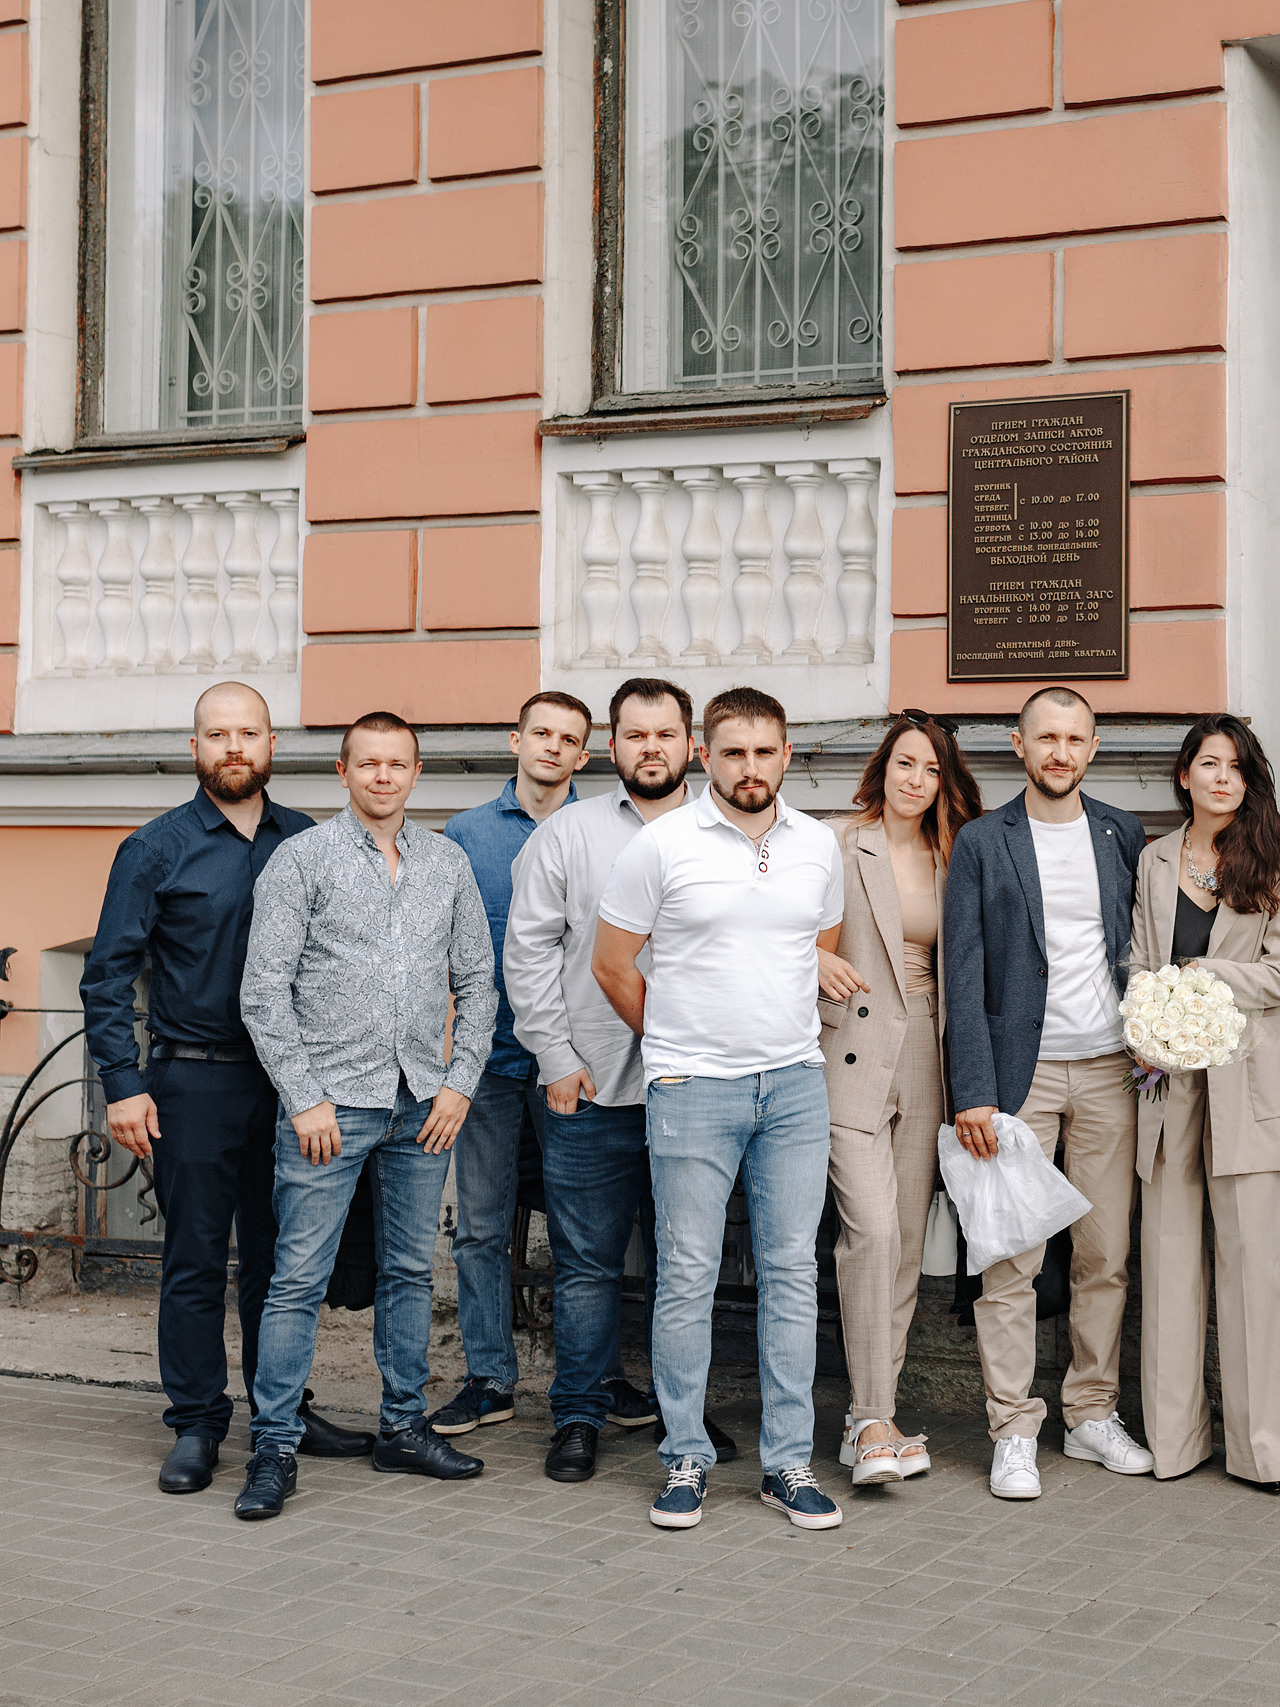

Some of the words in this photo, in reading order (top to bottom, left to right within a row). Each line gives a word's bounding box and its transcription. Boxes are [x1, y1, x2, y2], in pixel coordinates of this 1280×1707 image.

[991, 420, 1027, 430] ПРИЕМ
[1031, 416, 1083, 427] ГРАЖДАН
[971, 433, 1019, 444] ОТДЕЛОМ
[1024, 431, 1065, 441] ЗАПИСИ
[1070, 428, 1103, 437] АКТОВ
[962, 444, 1046, 458] ГРАЖДАНСКОГО
[1050, 440, 1113, 452] СОСТОЯНИЯ
[974, 457, 1053, 470] ЦЕНТРАЛЬНОГО
[1058, 453, 1099, 464] РАЙОНА
[974, 483, 1011, 492] ВТОРНИК
[974, 494, 1001, 502] СРЕДА
[1031, 495, 1054, 504] 10.00
[1076, 493, 1100, 502] 17.00
[974, 504, 1009, 512] ЧЕТВЕРГ
[974, 514, 1012, 522] ПЯТНИЦА
[974, 525, 1011, 533] СУББОТА
[1030, 520, 1053, 530] 10.00
[1076, 519, 1100, 528] 16.00
[974, 535, 1012, 543] ПЕРЕРЫВ
[1030, 532, 1053, 541] 13.00
[1075, 529, 1099, 538] 14.00
[990, 552, 1047, 565] ВЫХОДНОЙ
[1052, 553, 1080, 563] ДЕНЬ
[990, 581, 1025, 590] ПРИЕМ
[1031, 579, 1082, 589] ГРАЖДАН
[960, 593, 1034, 604] НАЧАЛЬНИКОМ
[1040, 592, 1081, 602] ОТДЕЛА
[1087, 590, 1114, 598] ЗАГС
[974, 606, 1011, 614] ВТОРНИК
[1029, 603, 1051, 612] 14.00
[1076, 602, 1099, 610] 17.00
[1029, 615, 1051, 623] 10.00
[1075, 613, 1099, 622] 13.00
[996, 639, 1051, 649] САНИТАРНЫЙ
[957, 651, 1004, 660] ПОСЛЕДНИЙ
[1008, 650, 1044, 658] РАБОЧИЙ
[1048, 651, 1070, 659] ДЕНЬ
[1074, 649, 1117, 658] КВАРТАЛА
